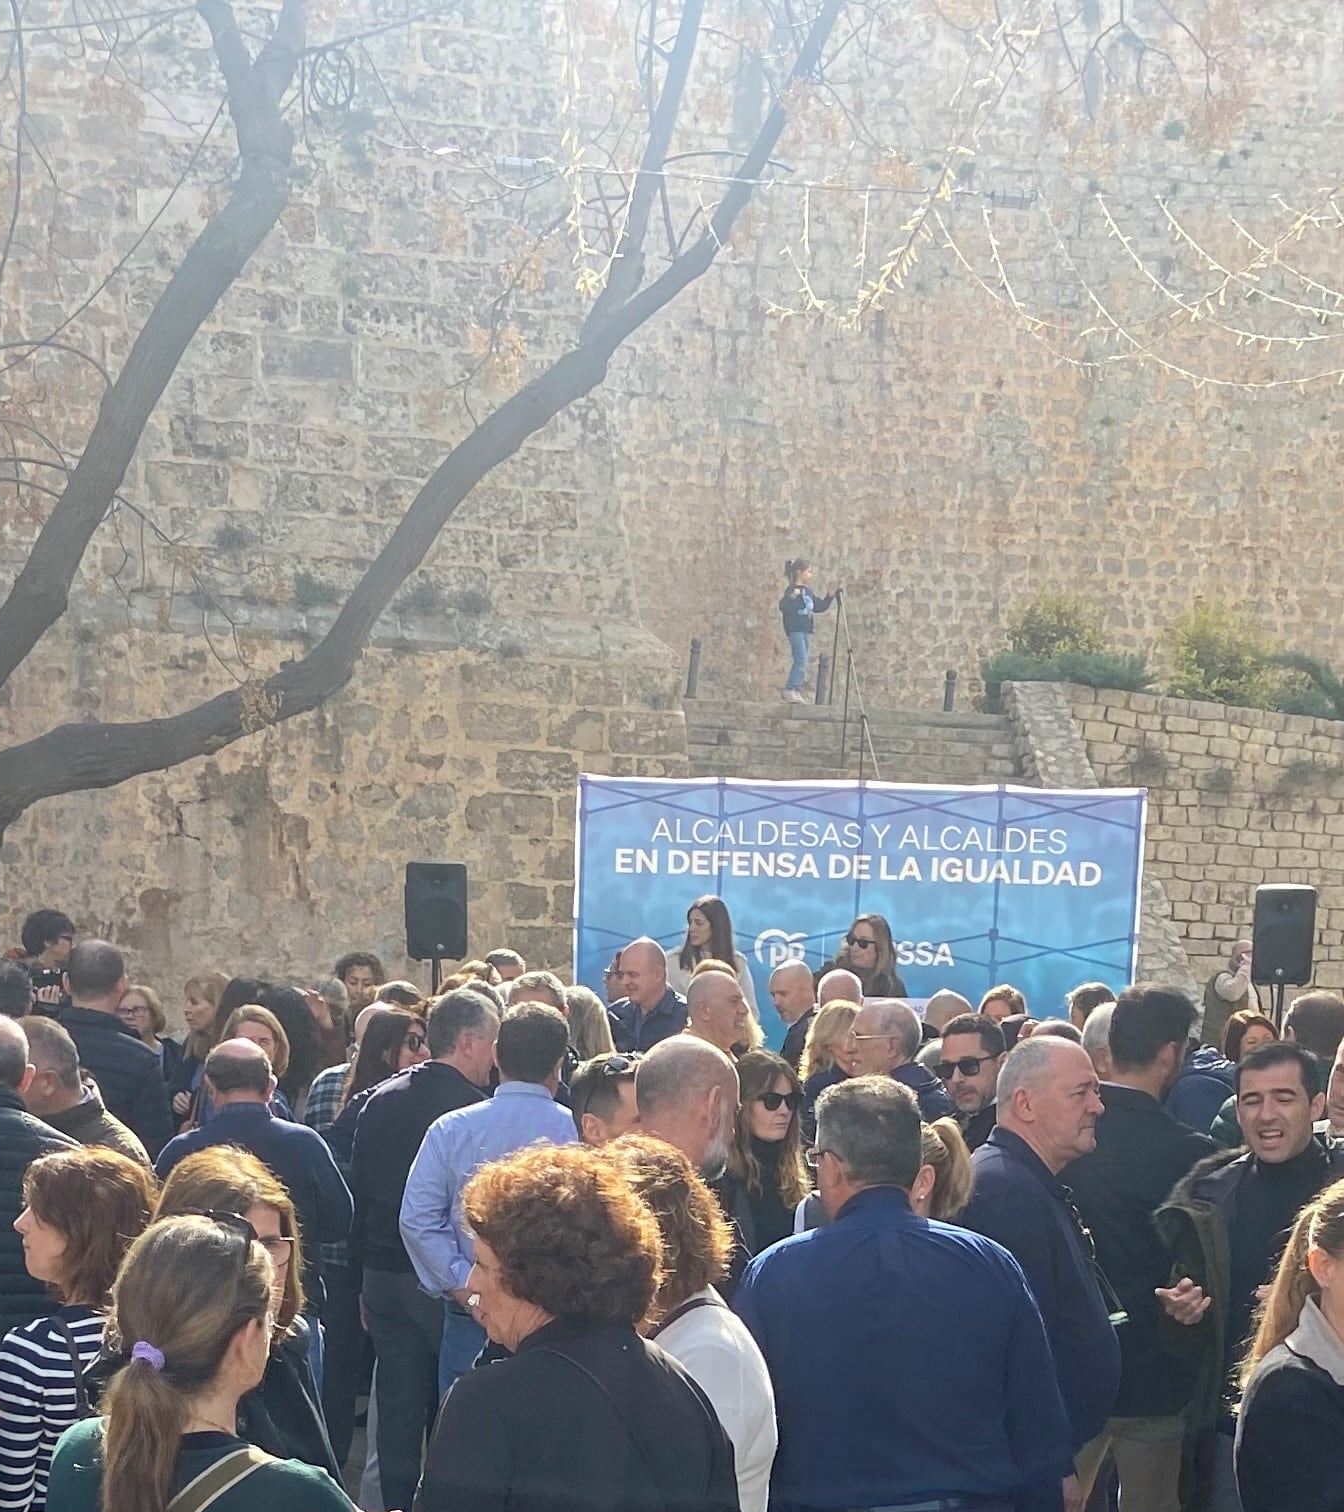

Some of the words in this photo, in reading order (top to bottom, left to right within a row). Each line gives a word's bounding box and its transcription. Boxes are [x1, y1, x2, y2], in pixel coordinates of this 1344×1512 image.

[650, 817, 863, 848] ALCALDESAS
[870, 823, 891, 849] Y
[899, 825, 1068, 854] ALCALDES
[614, 848, 658, 875] EN
[667, 850, 820, 879] DEFENSA
[827, 854, 872, 881] DE
[879, 855, 922, 882] LA
[930, 857, 1103, 887] IGUALDAD
[893, 940, 955, 967] SSA
